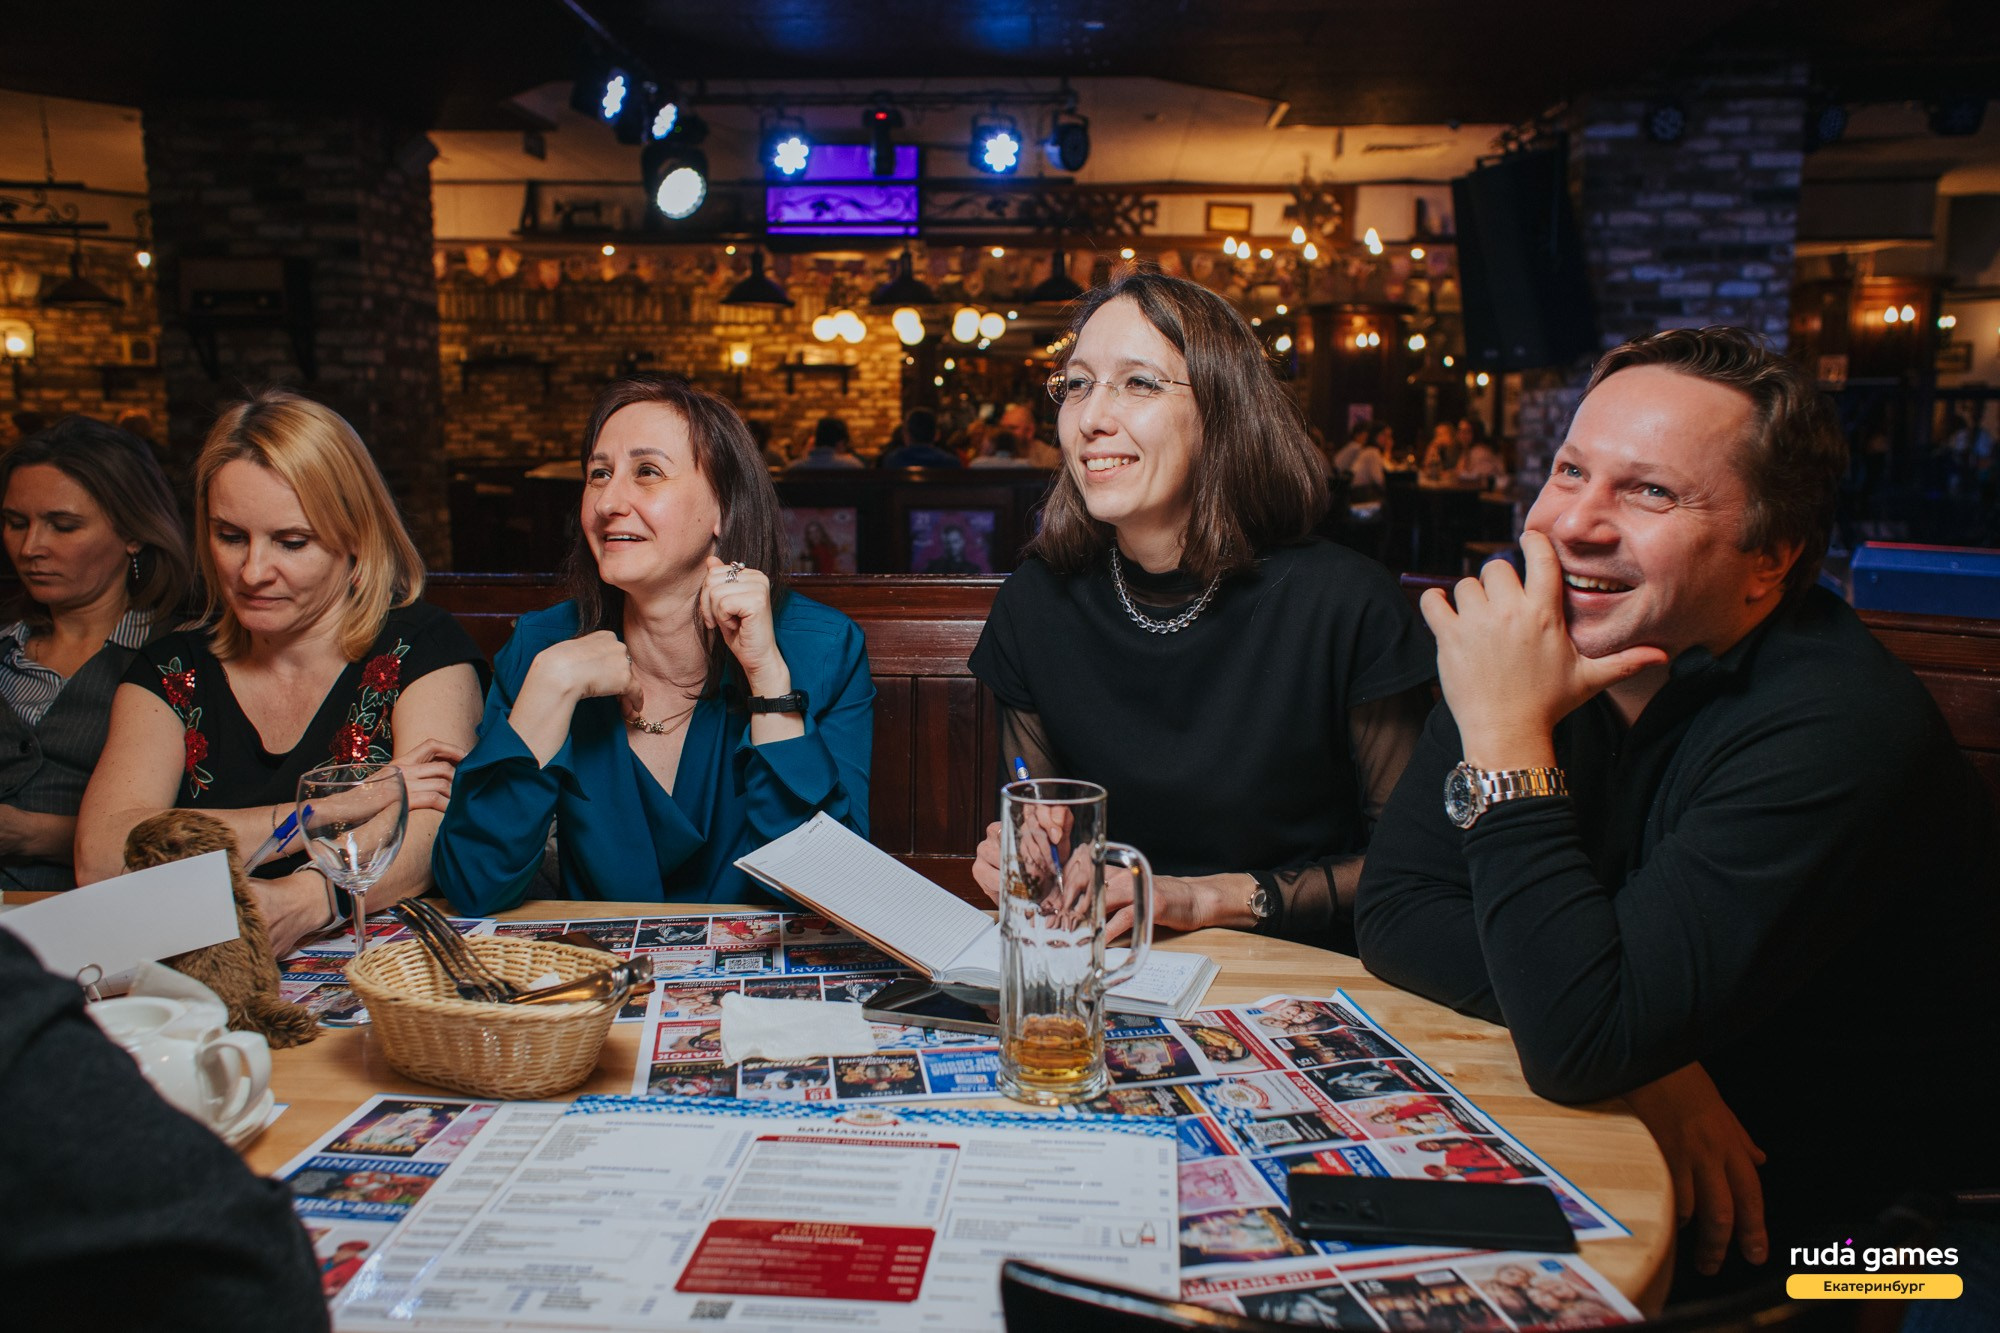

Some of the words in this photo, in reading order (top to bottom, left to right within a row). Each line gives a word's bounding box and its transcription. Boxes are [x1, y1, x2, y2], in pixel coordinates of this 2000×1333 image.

[647, 944, 768, 953] MAXIMILIANS.RU
[1105, 1028, 1164, 1039] ИМЕН
[657, 1049, 723, 1060] ОДАРОК
[1290, 1075, 1362, 1138] MAXIMILIANS.RU
